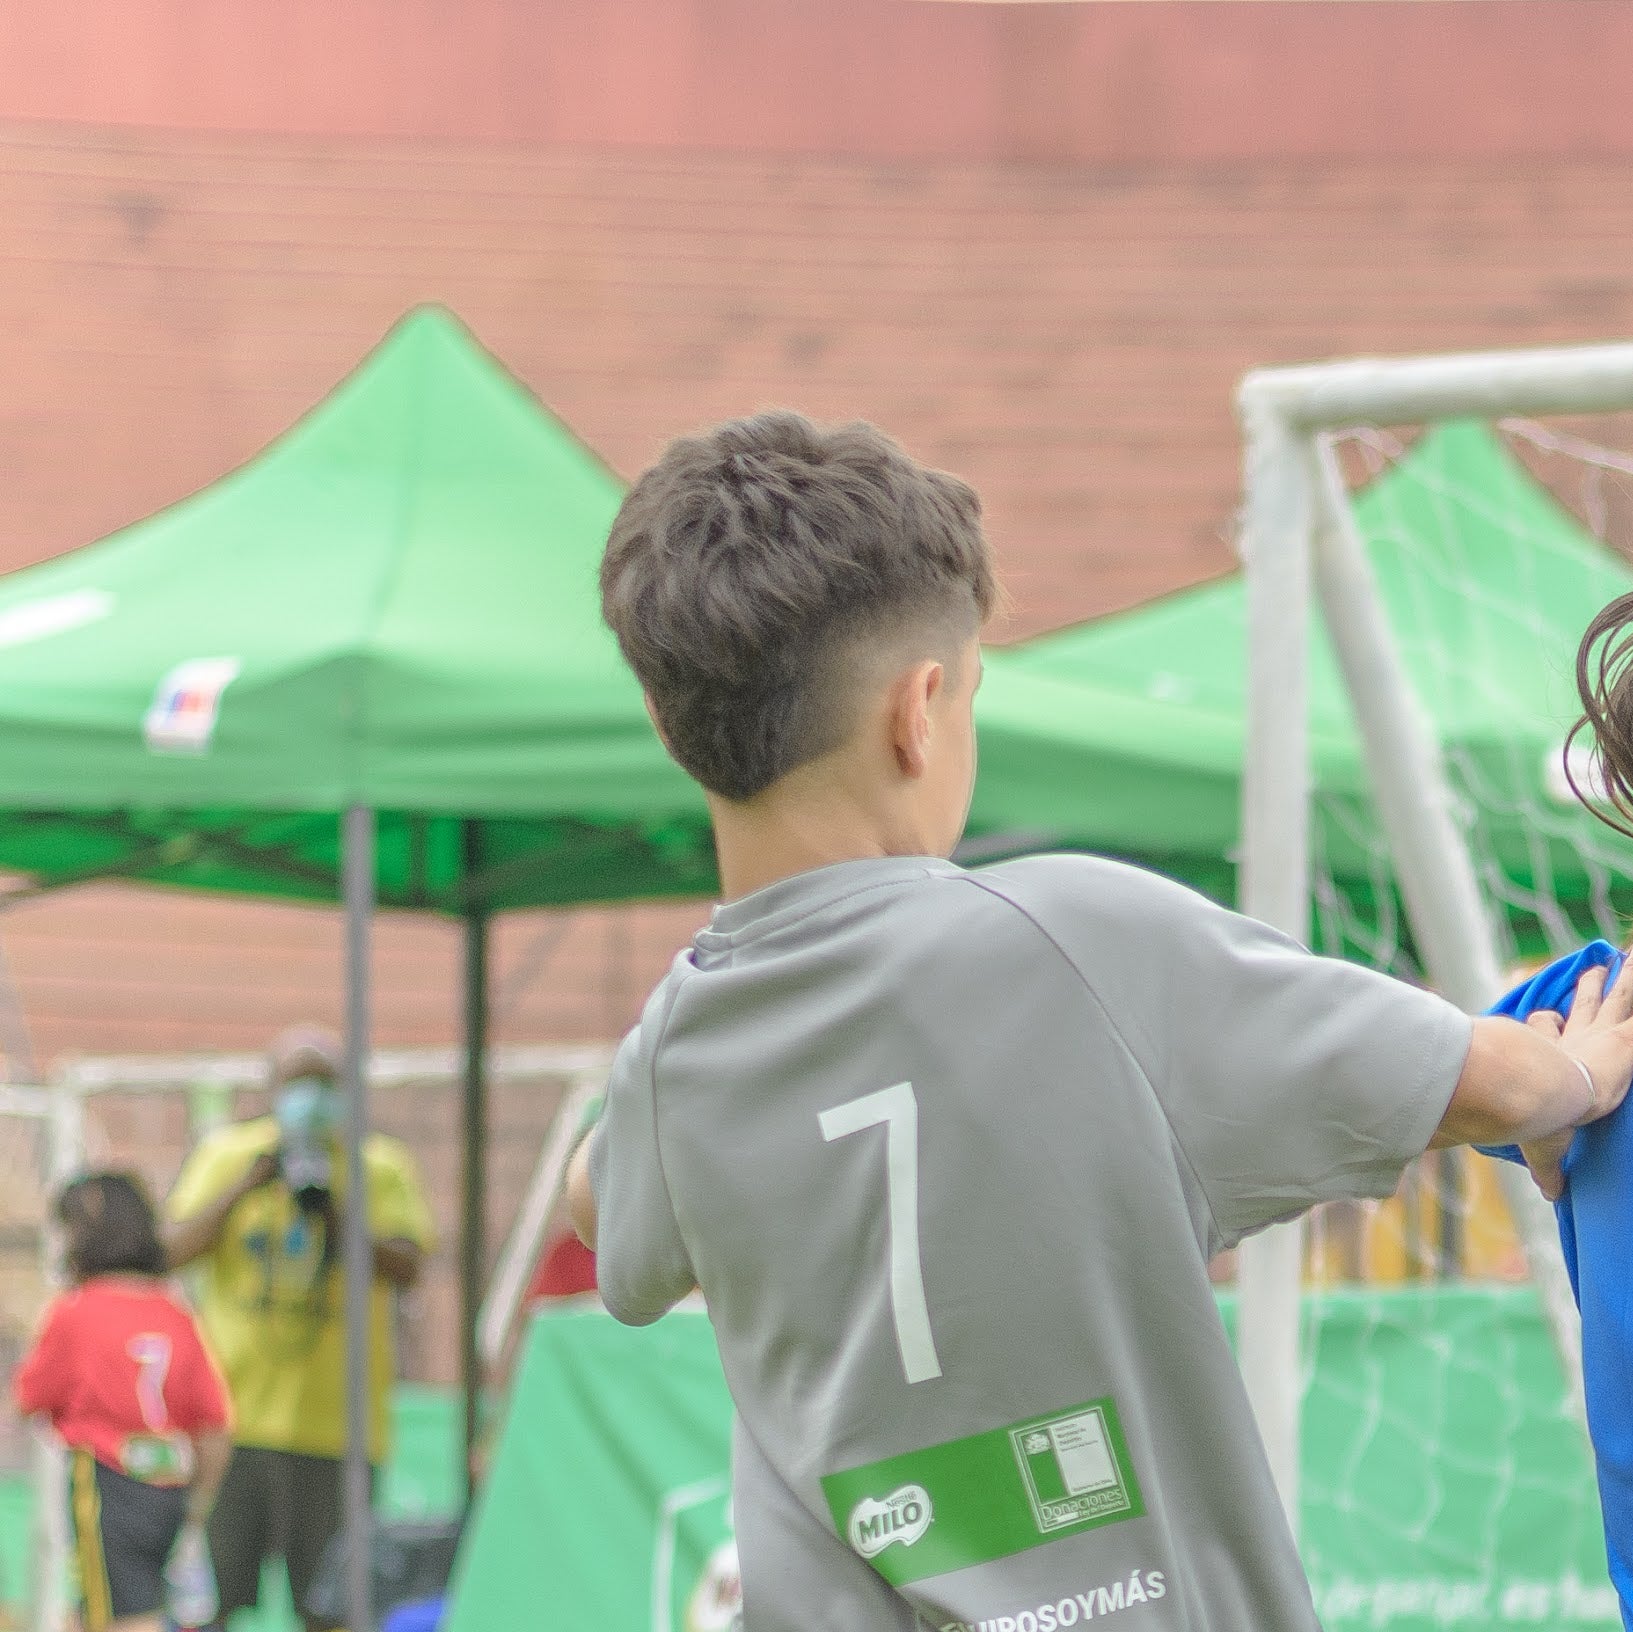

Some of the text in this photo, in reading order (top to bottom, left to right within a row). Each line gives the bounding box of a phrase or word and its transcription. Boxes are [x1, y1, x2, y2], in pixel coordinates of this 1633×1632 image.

[817, 1081, 942, 1384] 7
[859, 1501, 922, 1545] MILO
[1041, 1489, 1122, 1521] Donaciones
